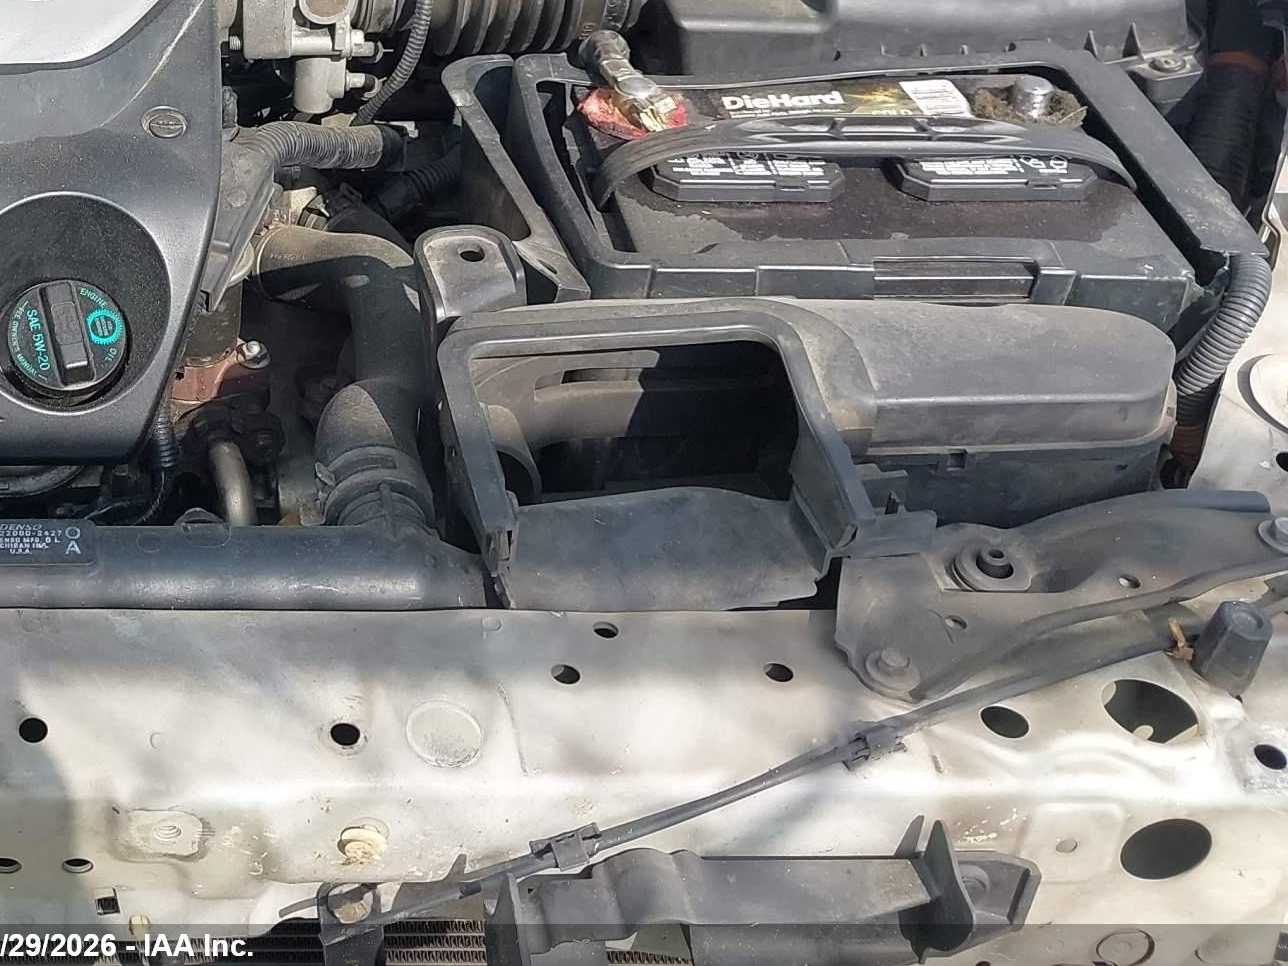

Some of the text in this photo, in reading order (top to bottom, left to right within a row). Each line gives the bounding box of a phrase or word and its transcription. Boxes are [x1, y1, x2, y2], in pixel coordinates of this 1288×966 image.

[721, 91, 846, 110] DieHard
[15, 306, 25, 320] SEE
[79, 288, 108, 308] ENGINE
[104, 347, 117, 362] OIL
[26, 309, 51, 371] SAE 5W-20
[0, 523, 42, 531] DENSO
